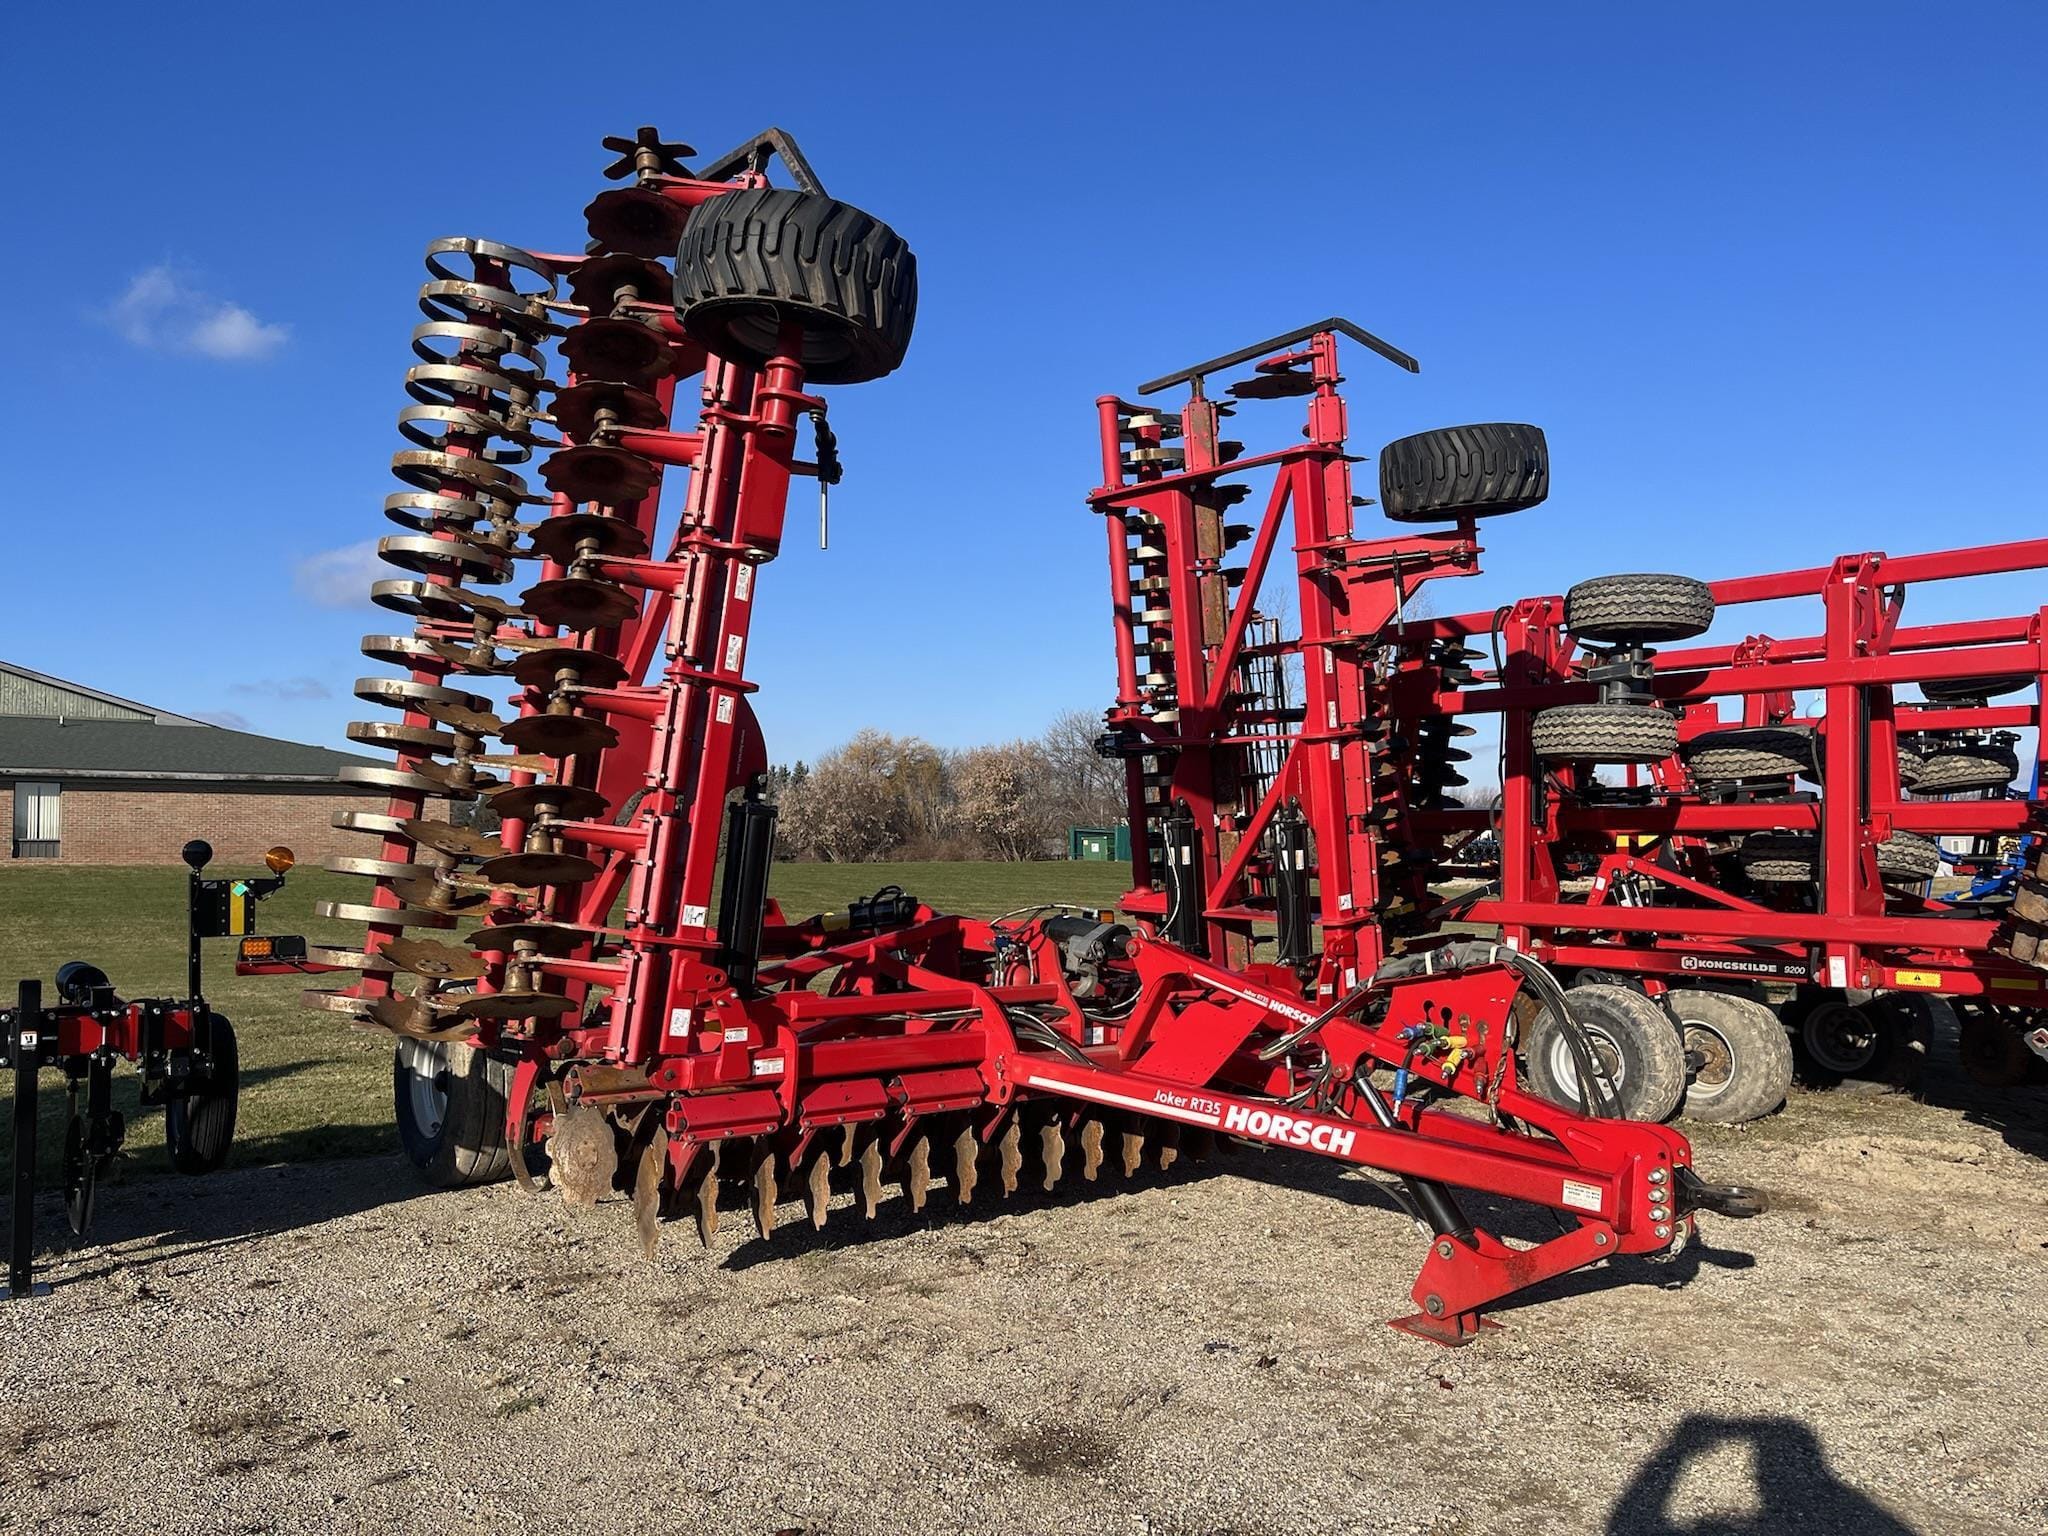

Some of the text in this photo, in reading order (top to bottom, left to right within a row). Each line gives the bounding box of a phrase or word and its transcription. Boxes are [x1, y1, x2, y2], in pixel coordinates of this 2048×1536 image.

[1698, 959, 1777, 973] KONGSKILDE
[1784, 965, 1806, 975] 9200
[1269, 1000, 1317, 1025] HORSCH
[1154, 1089, 1356, 1156] Joker RT35 HORSCH
